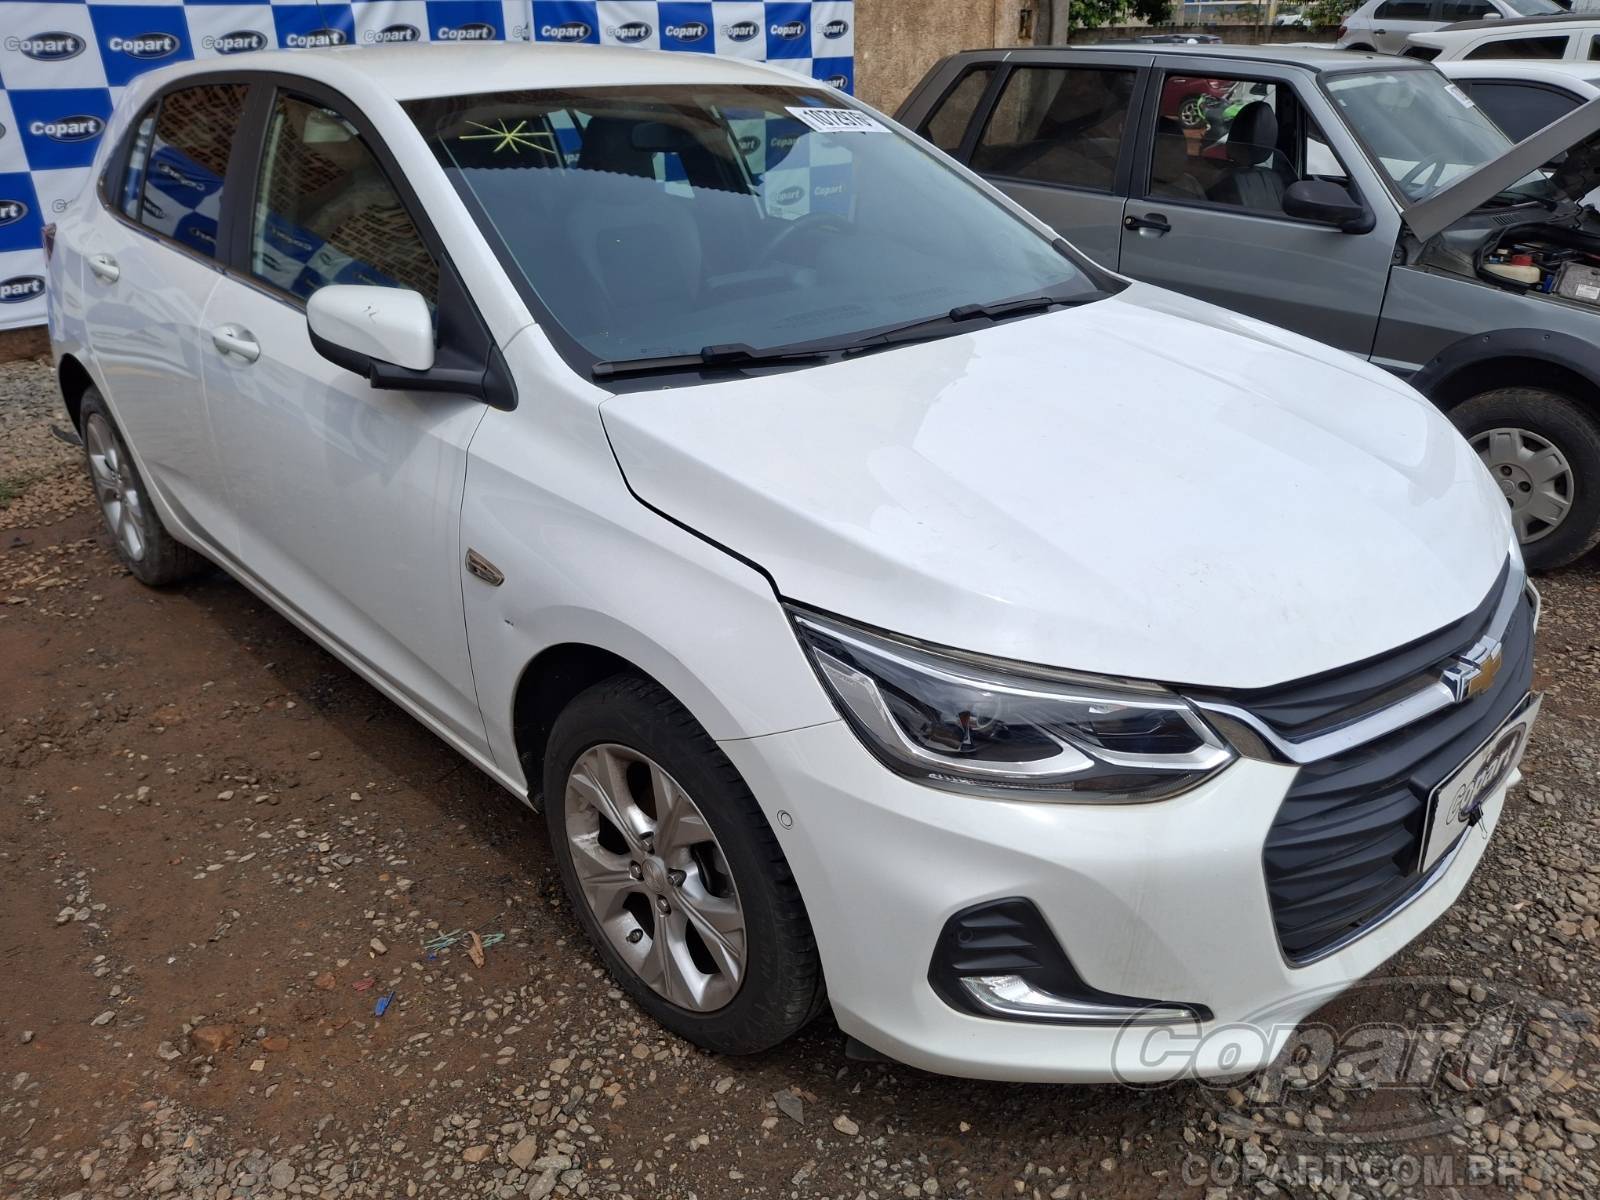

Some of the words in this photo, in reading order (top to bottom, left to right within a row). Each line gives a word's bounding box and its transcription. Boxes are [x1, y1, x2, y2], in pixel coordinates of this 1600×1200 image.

[364, 25, 412, 42] Copart
[437, 25, 488, 41] Copart
[541, 24, 586, 39] Copart
[608, 24, 645, 40] Copart
[665, 24, 703, 39] Copart
[720, 24, 754, 38] Copart
[770, 23, 801, 37] Copart
[4, 36, 76, 55] Copart
[109, 37, 172, 54] Copart
[202, 35, 259, 51] Copart
[286, 32, 339, 48] Copart
[30, 120, 97, 137] Copart
